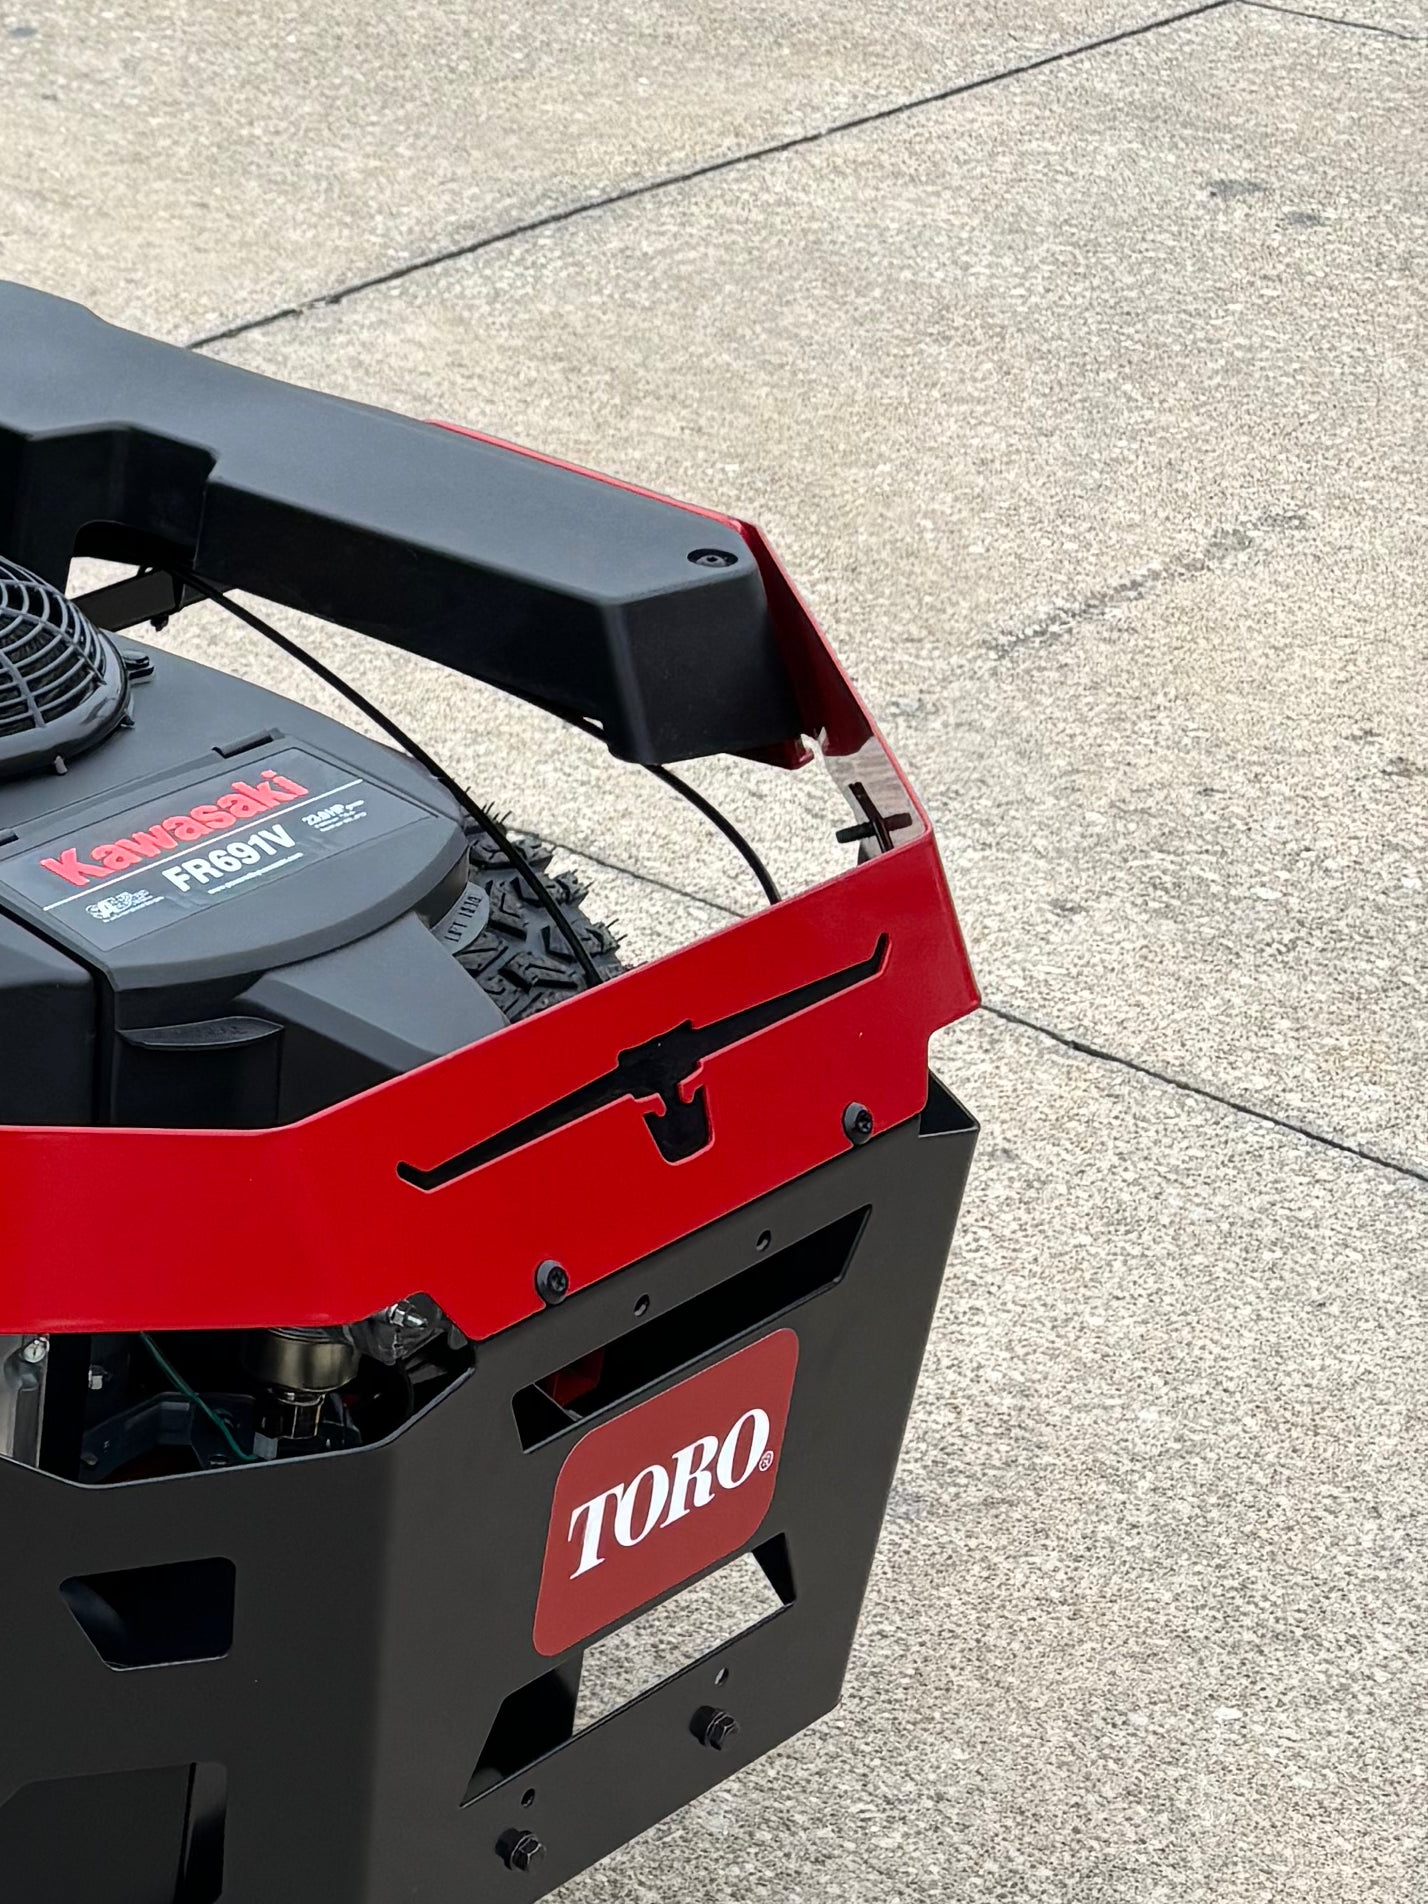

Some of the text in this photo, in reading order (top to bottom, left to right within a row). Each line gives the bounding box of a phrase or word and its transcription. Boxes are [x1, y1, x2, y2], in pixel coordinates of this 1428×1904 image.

[40, 769, 310, 887] Kawasaki
[161, 823, 297, 894] FR691V
[568, 1408, 771, 1580] TORO
